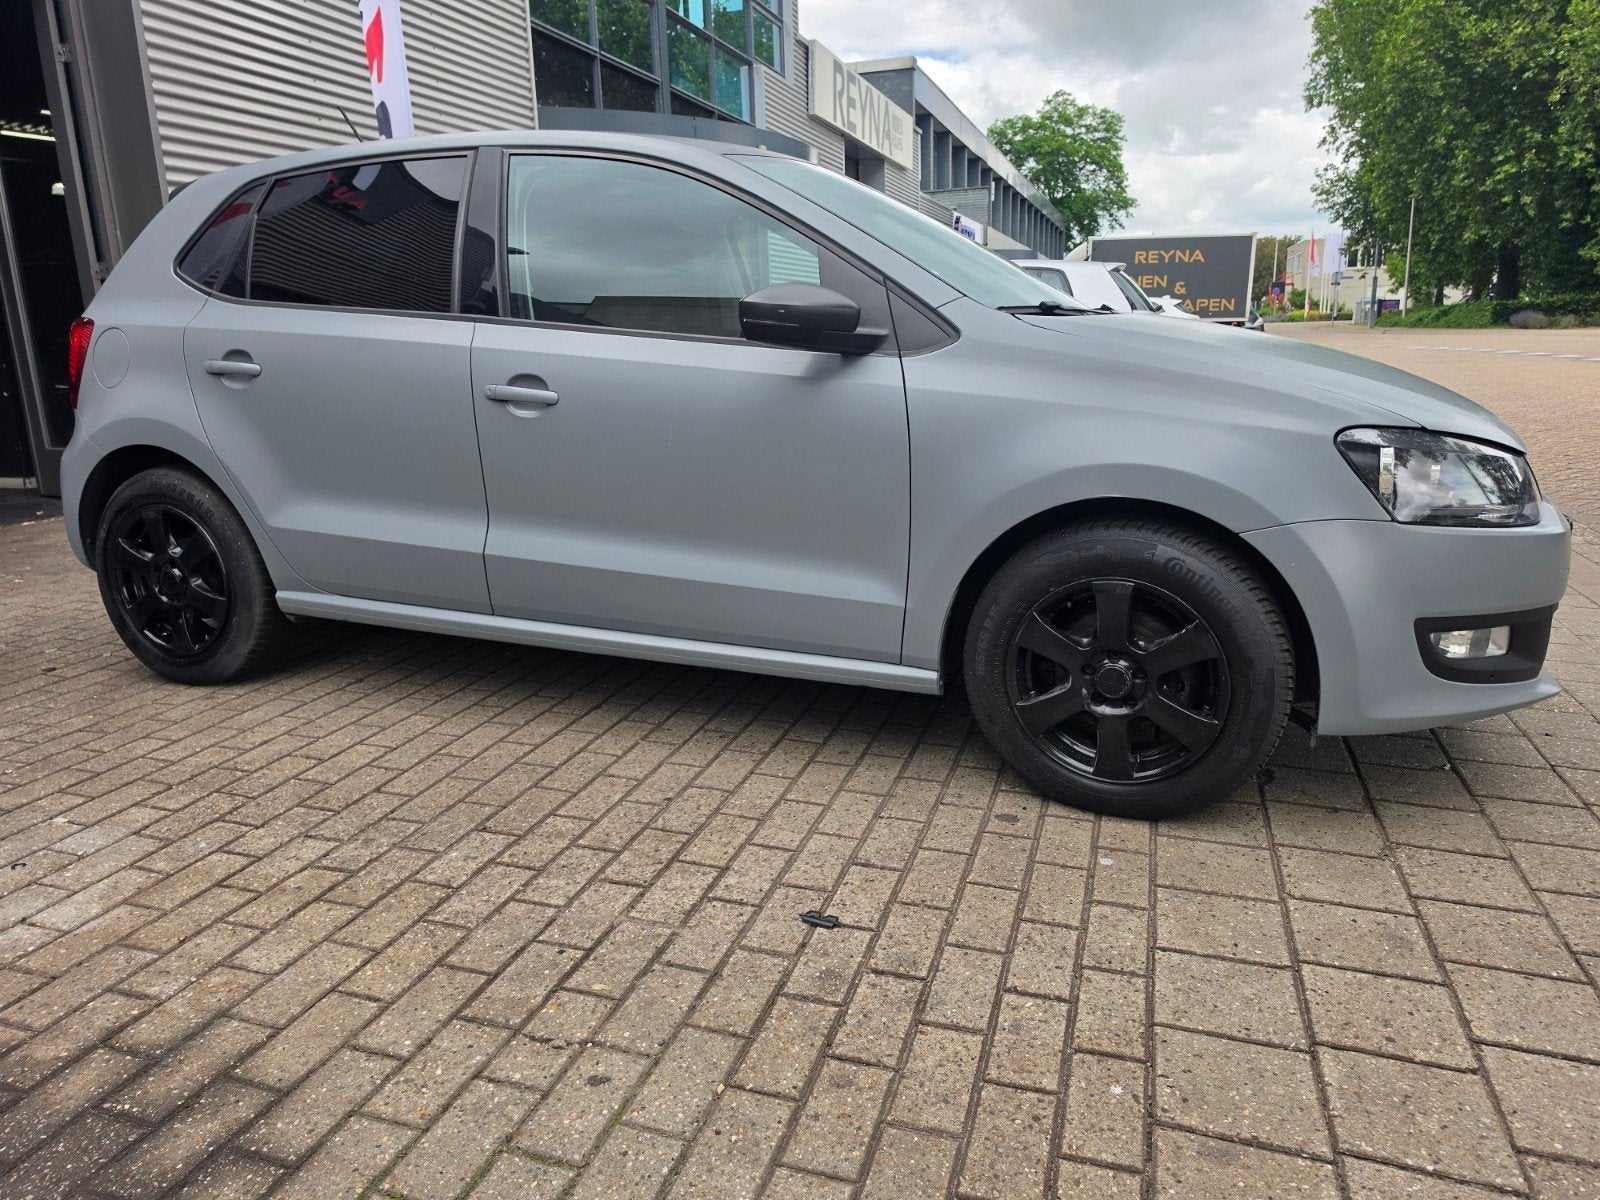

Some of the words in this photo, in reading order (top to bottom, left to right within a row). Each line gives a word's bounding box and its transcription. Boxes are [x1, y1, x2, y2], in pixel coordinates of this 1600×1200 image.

[833, 58, 893, 157] REYNA
[1135, 249, 1205, 264] REYNA
[1174, 281, 1187, 295] &
